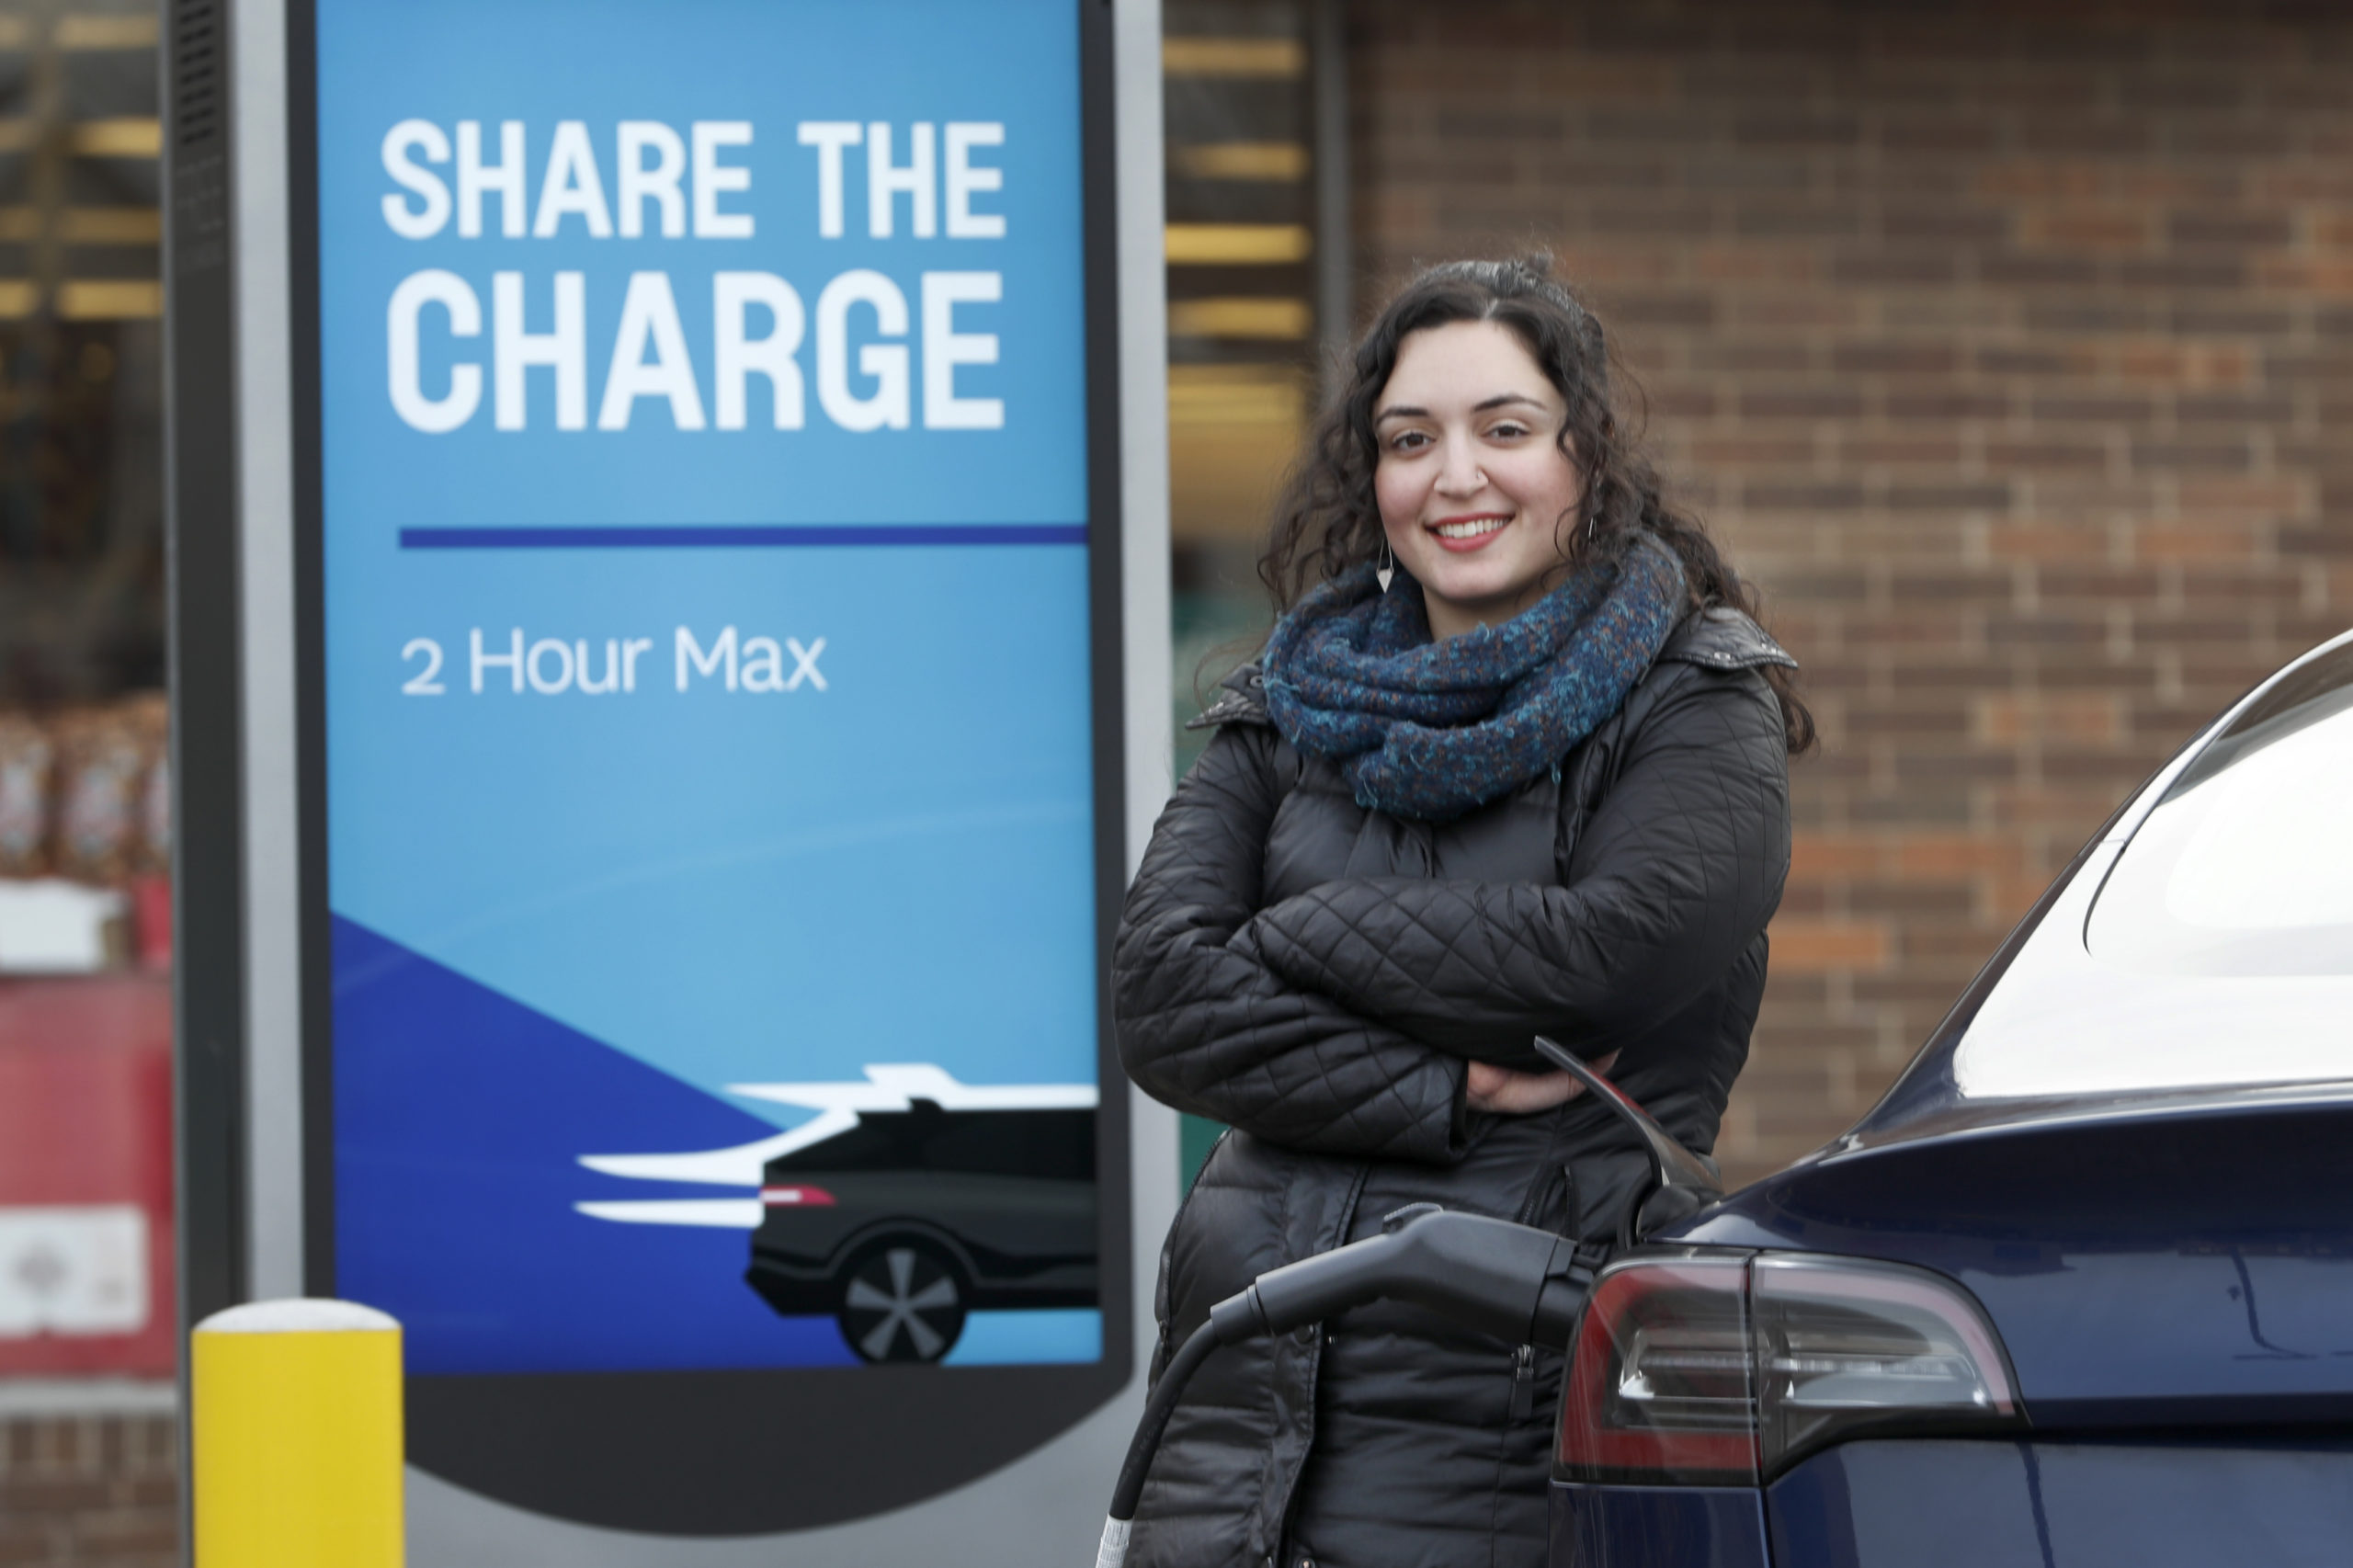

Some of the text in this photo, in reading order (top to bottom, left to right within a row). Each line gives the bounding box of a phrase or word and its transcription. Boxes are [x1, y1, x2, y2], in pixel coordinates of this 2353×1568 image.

[381, 119, 1006, 241] SHARE THE
[387, 267, 1006, 435] CHARGE
[401, 625, 828, 697] 2 Hour Max
